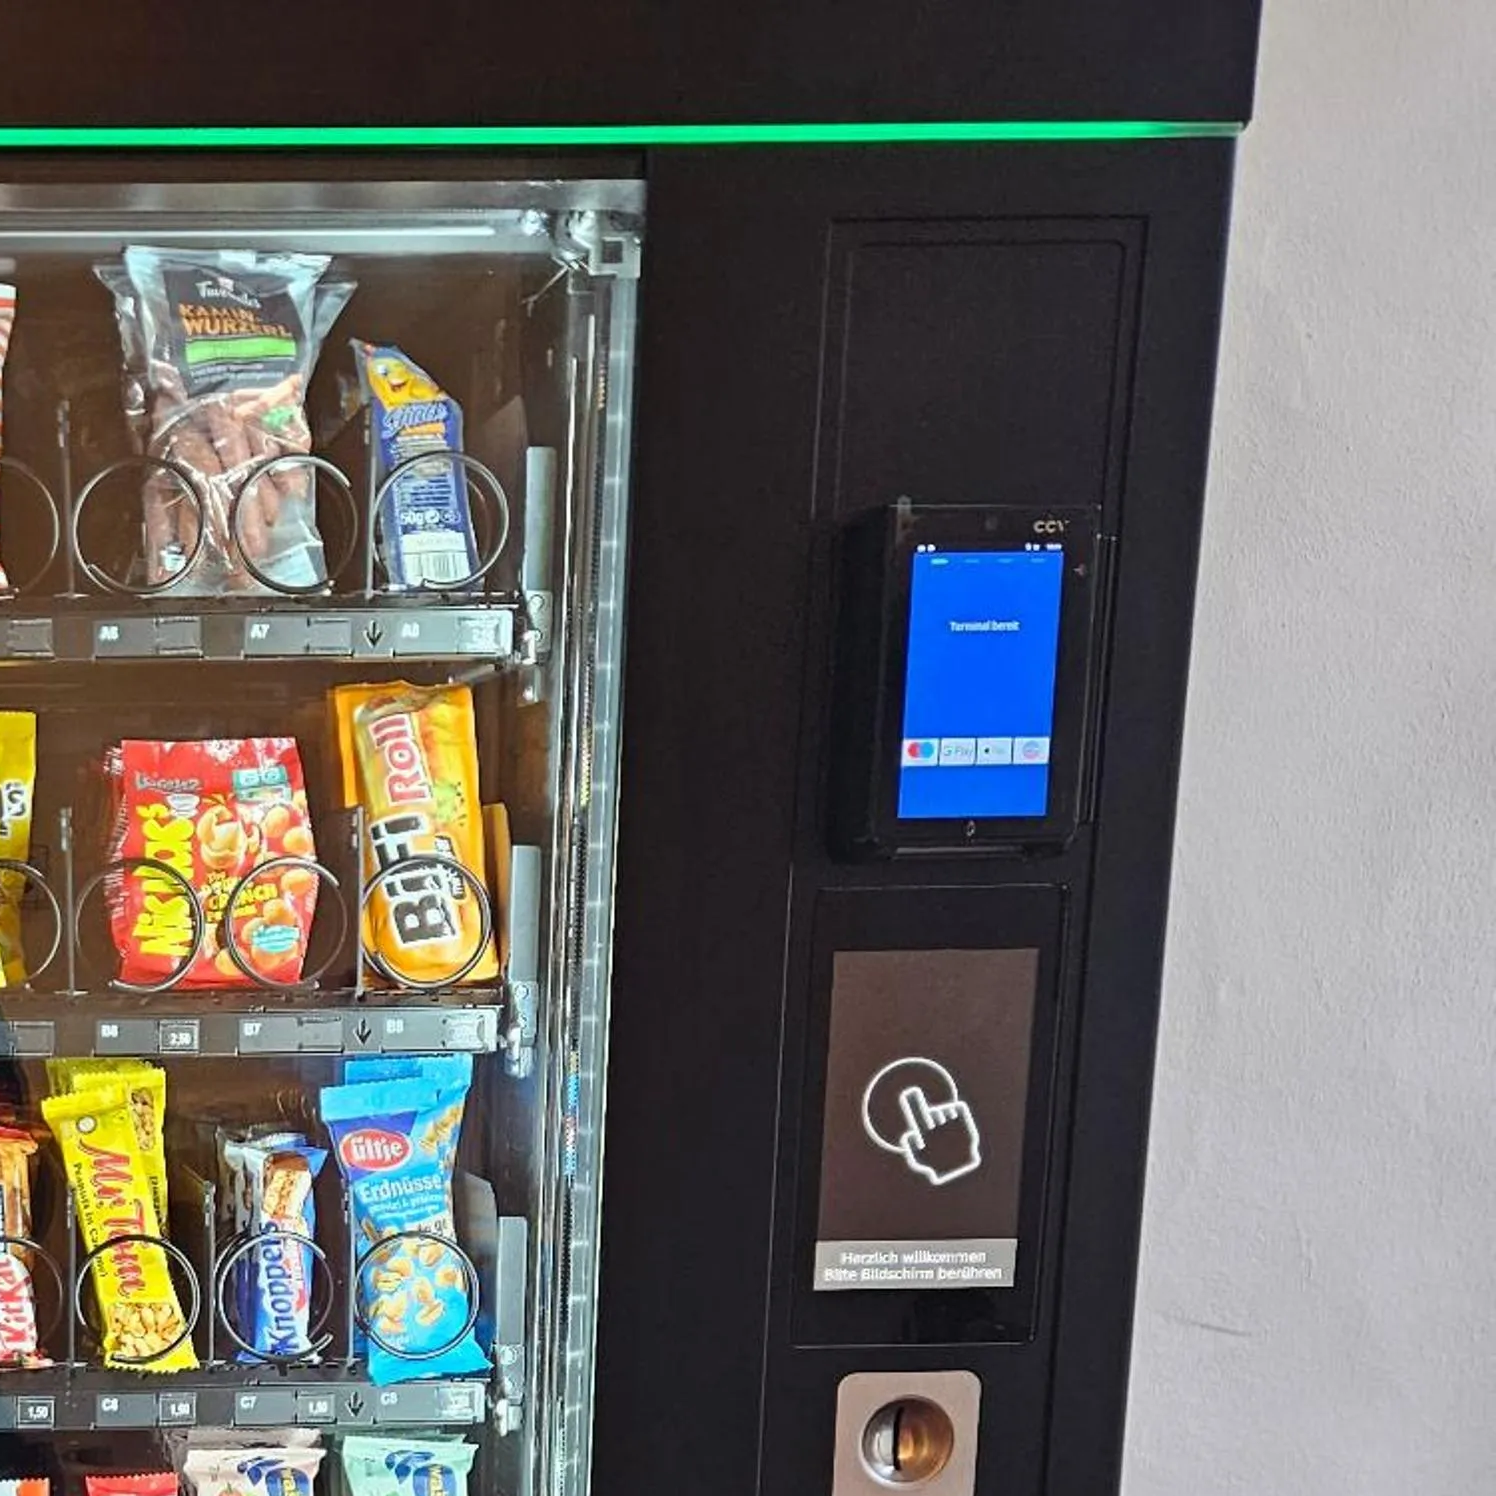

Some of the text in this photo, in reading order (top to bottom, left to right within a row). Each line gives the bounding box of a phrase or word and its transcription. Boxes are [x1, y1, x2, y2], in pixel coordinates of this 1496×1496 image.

[370, 712, 432, 806] Roll
[370, 815, 460, 945] BiFi
[350, 1132, 404, 1163] ültje
[359, 1174, 443, 1202] Erdnüsse
[840, 1250, 987, 1265] Herzlich willkommen
[860, 1265, 935, 1281] Bildschirm
[937, 1265, 1004, 1281] berühren
[261, 1220, 301, 1356] Knoppers
[27, 1405, 50, 1421] 1,50
